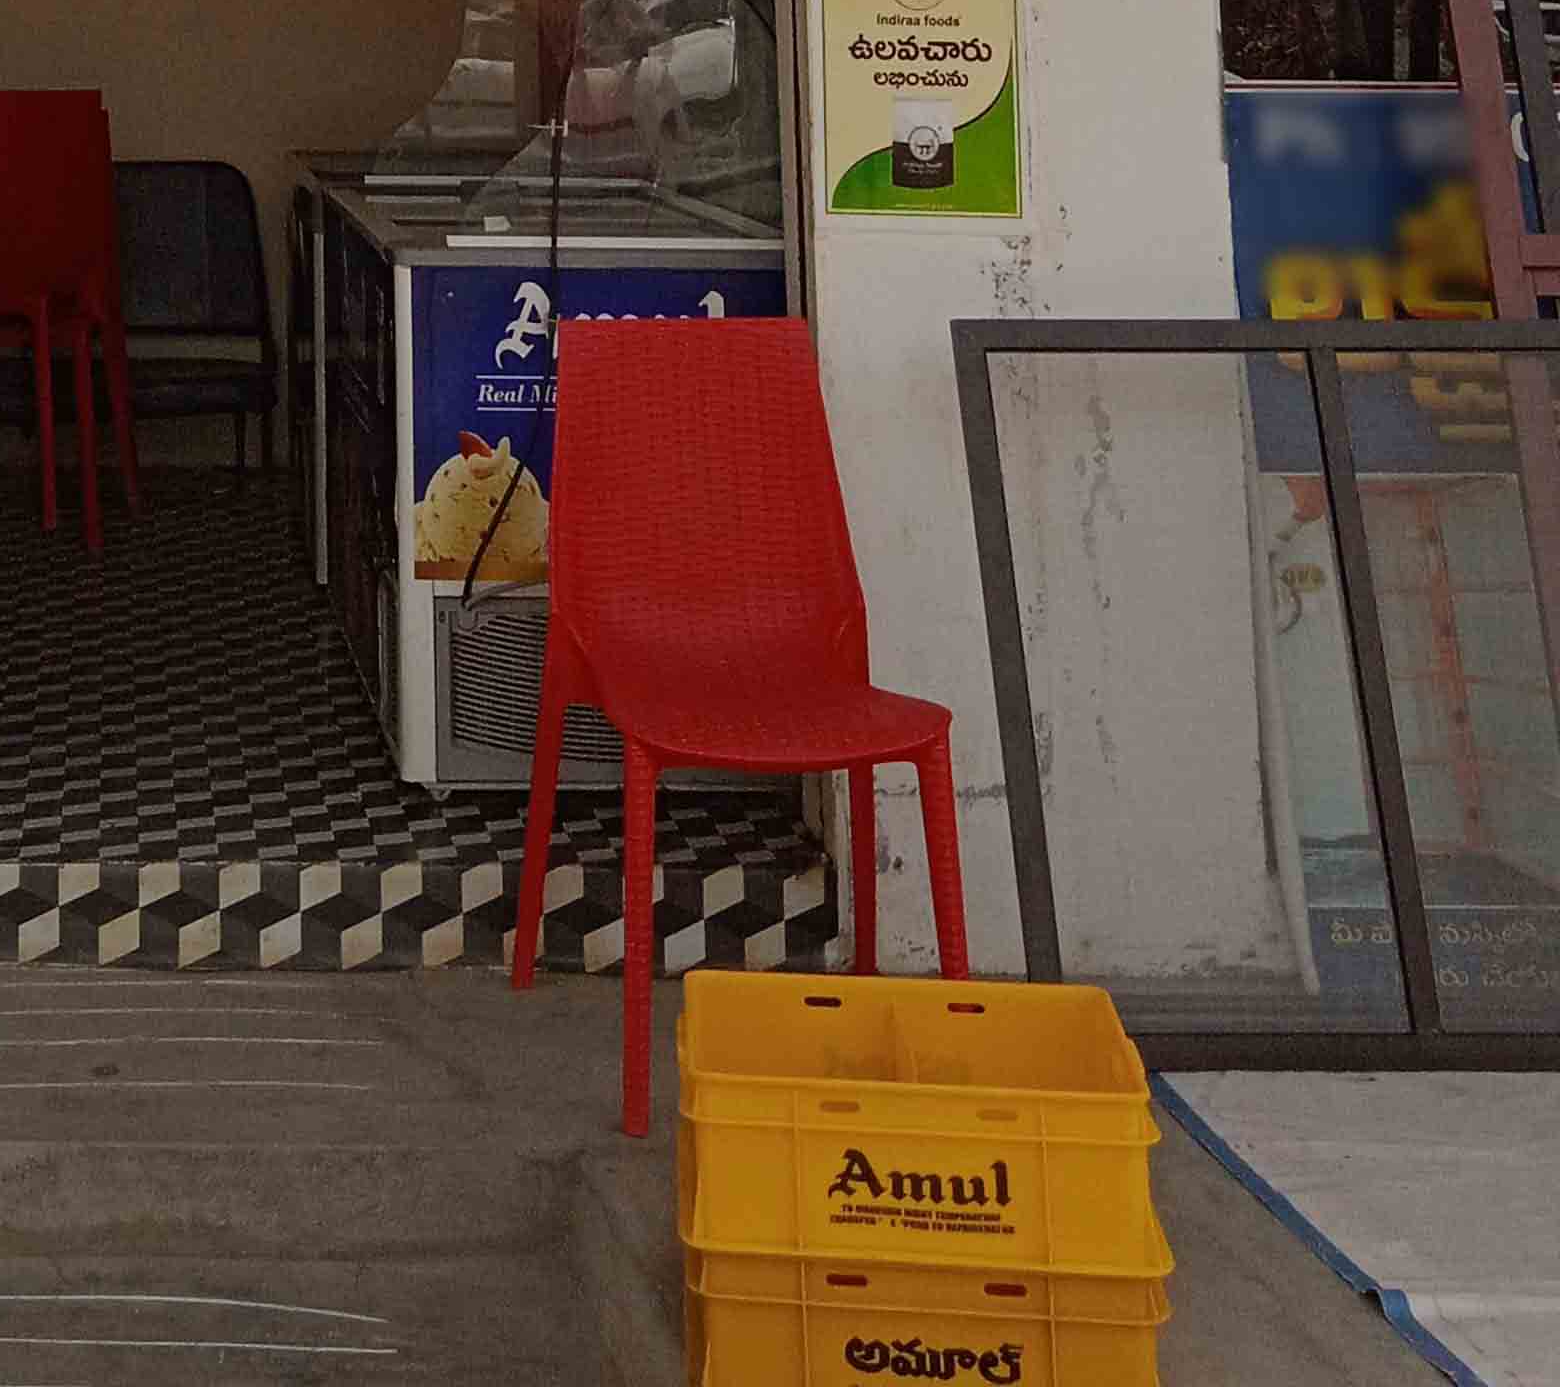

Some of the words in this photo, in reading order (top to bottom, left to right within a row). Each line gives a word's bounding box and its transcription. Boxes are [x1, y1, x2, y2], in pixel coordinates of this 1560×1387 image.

[924, 15, 960, 26] foods
[848, 33, 993, 62] ఉలవచారు
[873, 69, 969, 89] లభించును
[477, 383, 524, 404] Real
[828, 1147, 1013, 1207] Amul
[844, 1336, 1025, 1385] అమూల్
